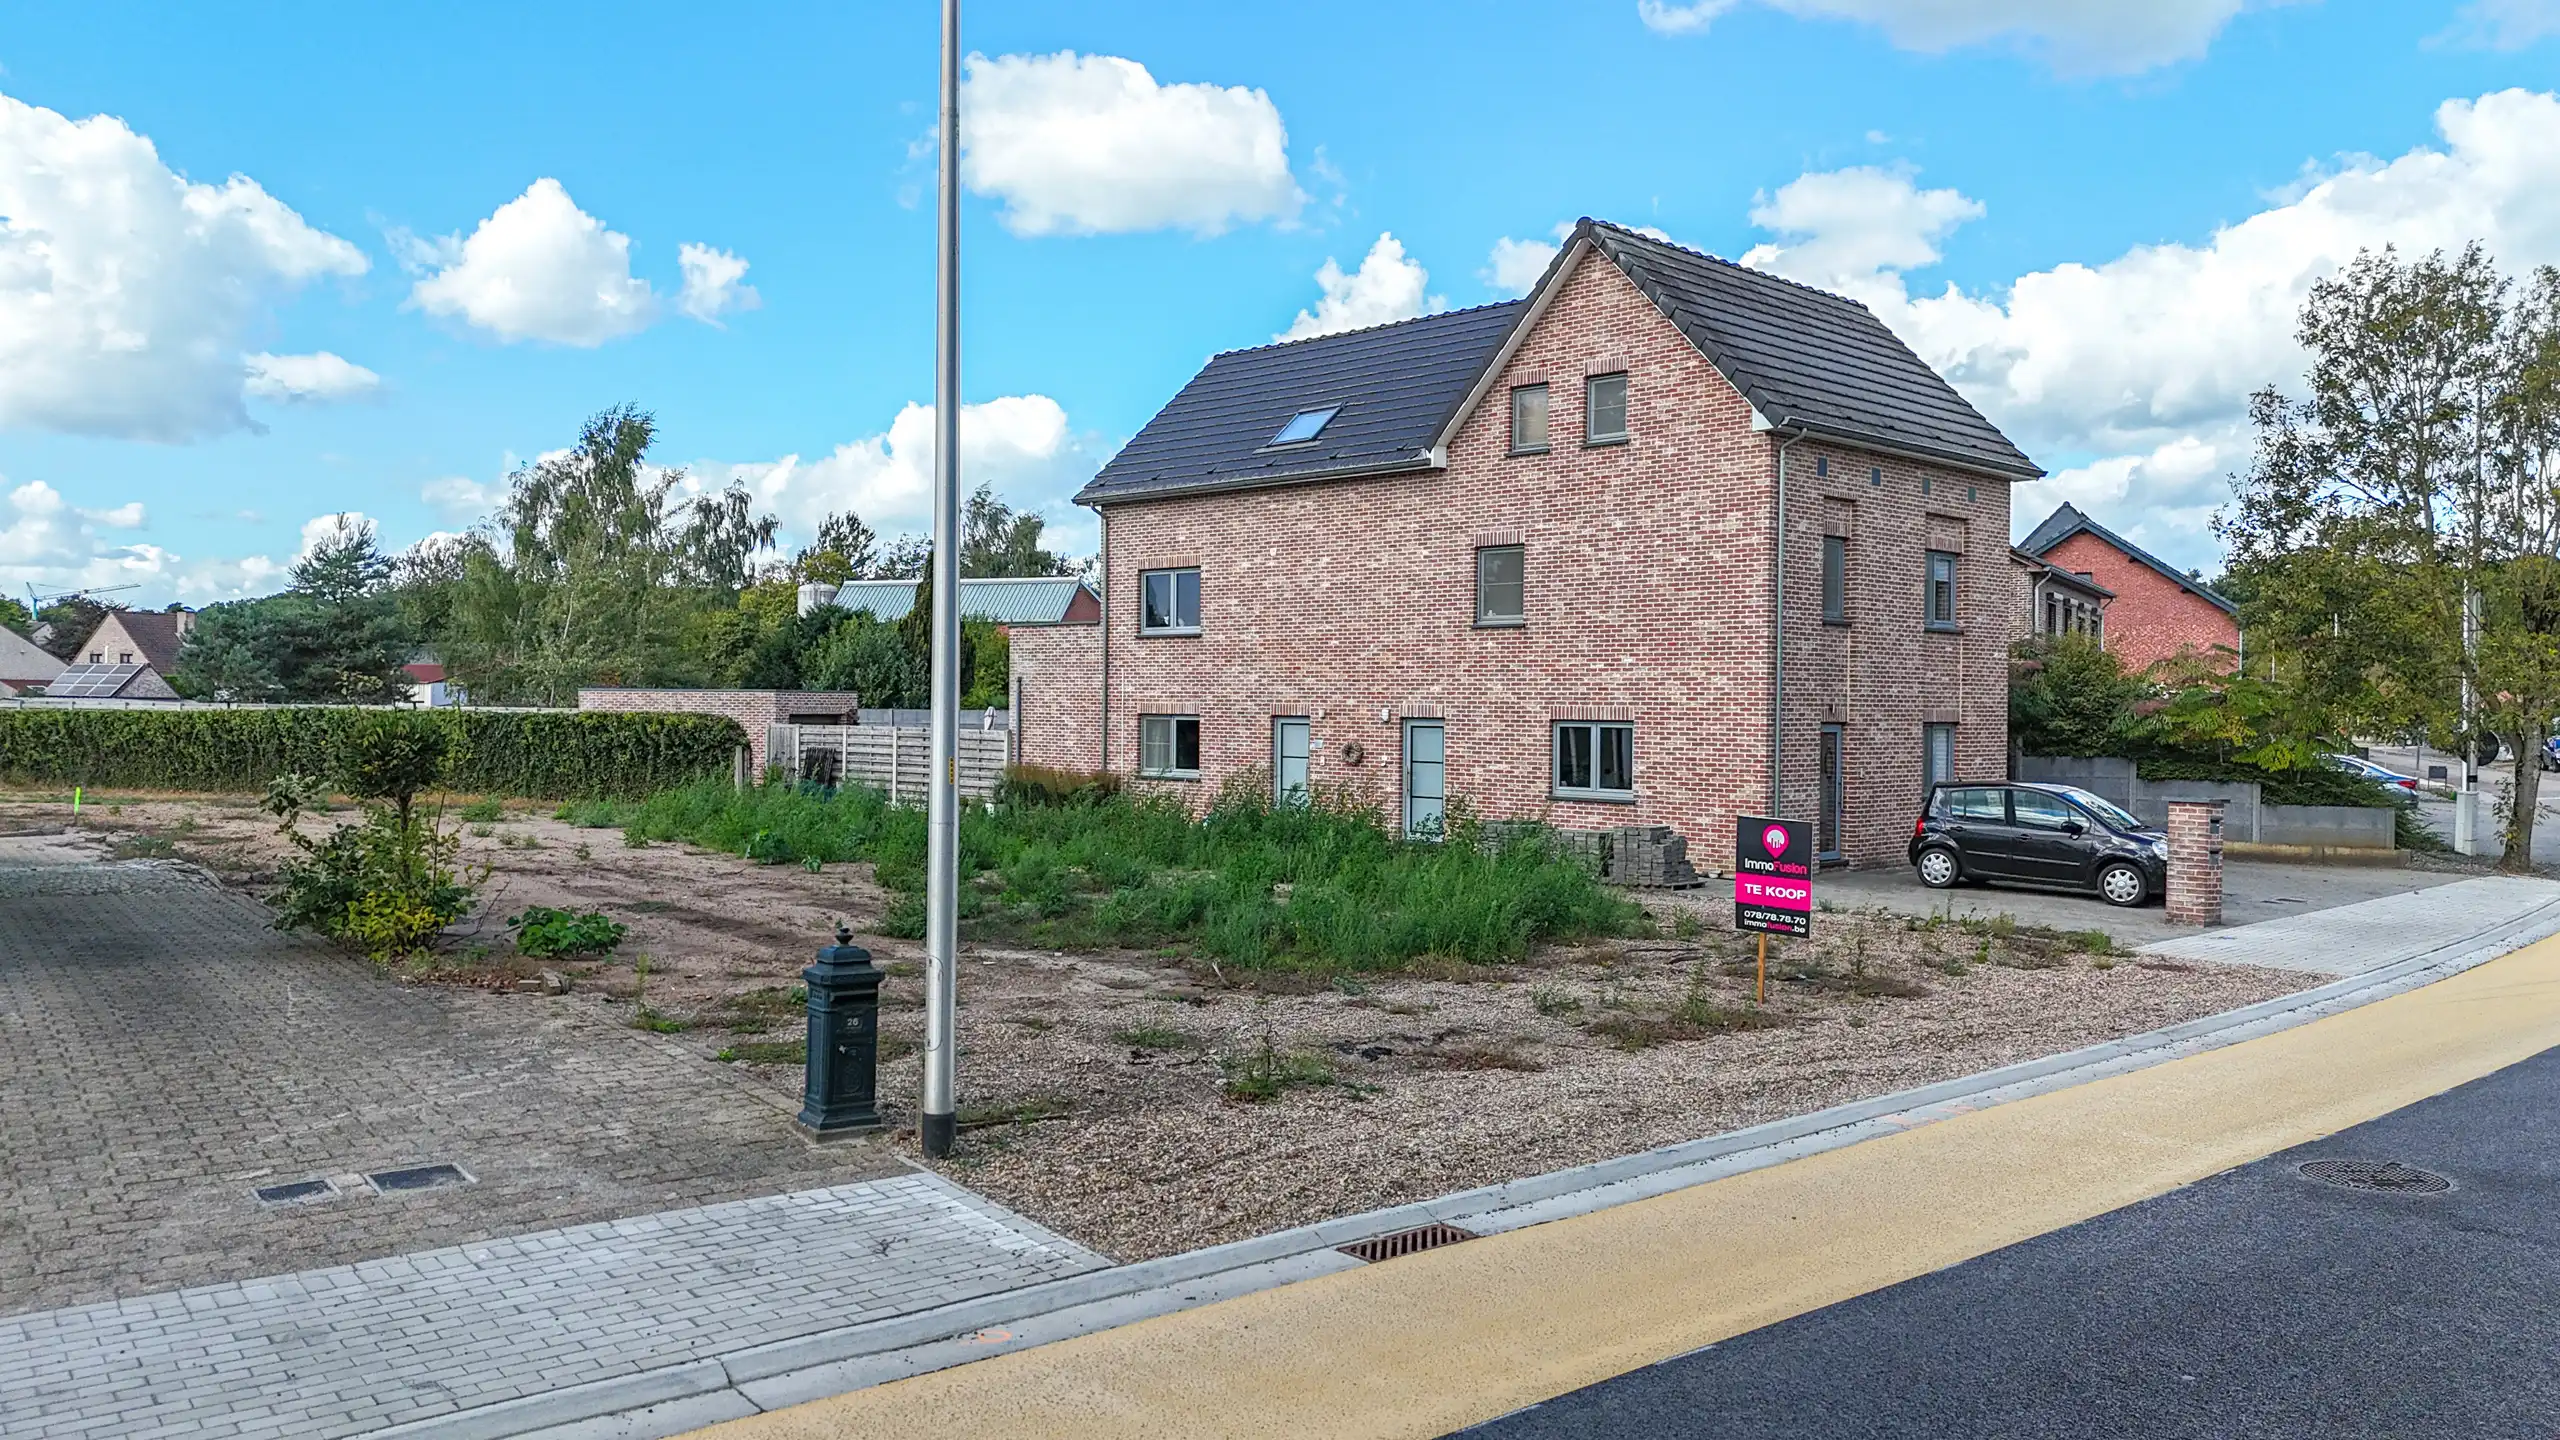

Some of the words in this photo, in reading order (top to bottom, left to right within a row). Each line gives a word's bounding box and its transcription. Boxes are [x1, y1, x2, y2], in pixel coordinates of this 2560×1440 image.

[1744, 858, 1807, 875] ImmoFusion
[1744, 883, 1762, 895] TE
[1765, 885, 1807, 900] KOOP
[1744, 910, 1806, 925] 078/78.78.70
